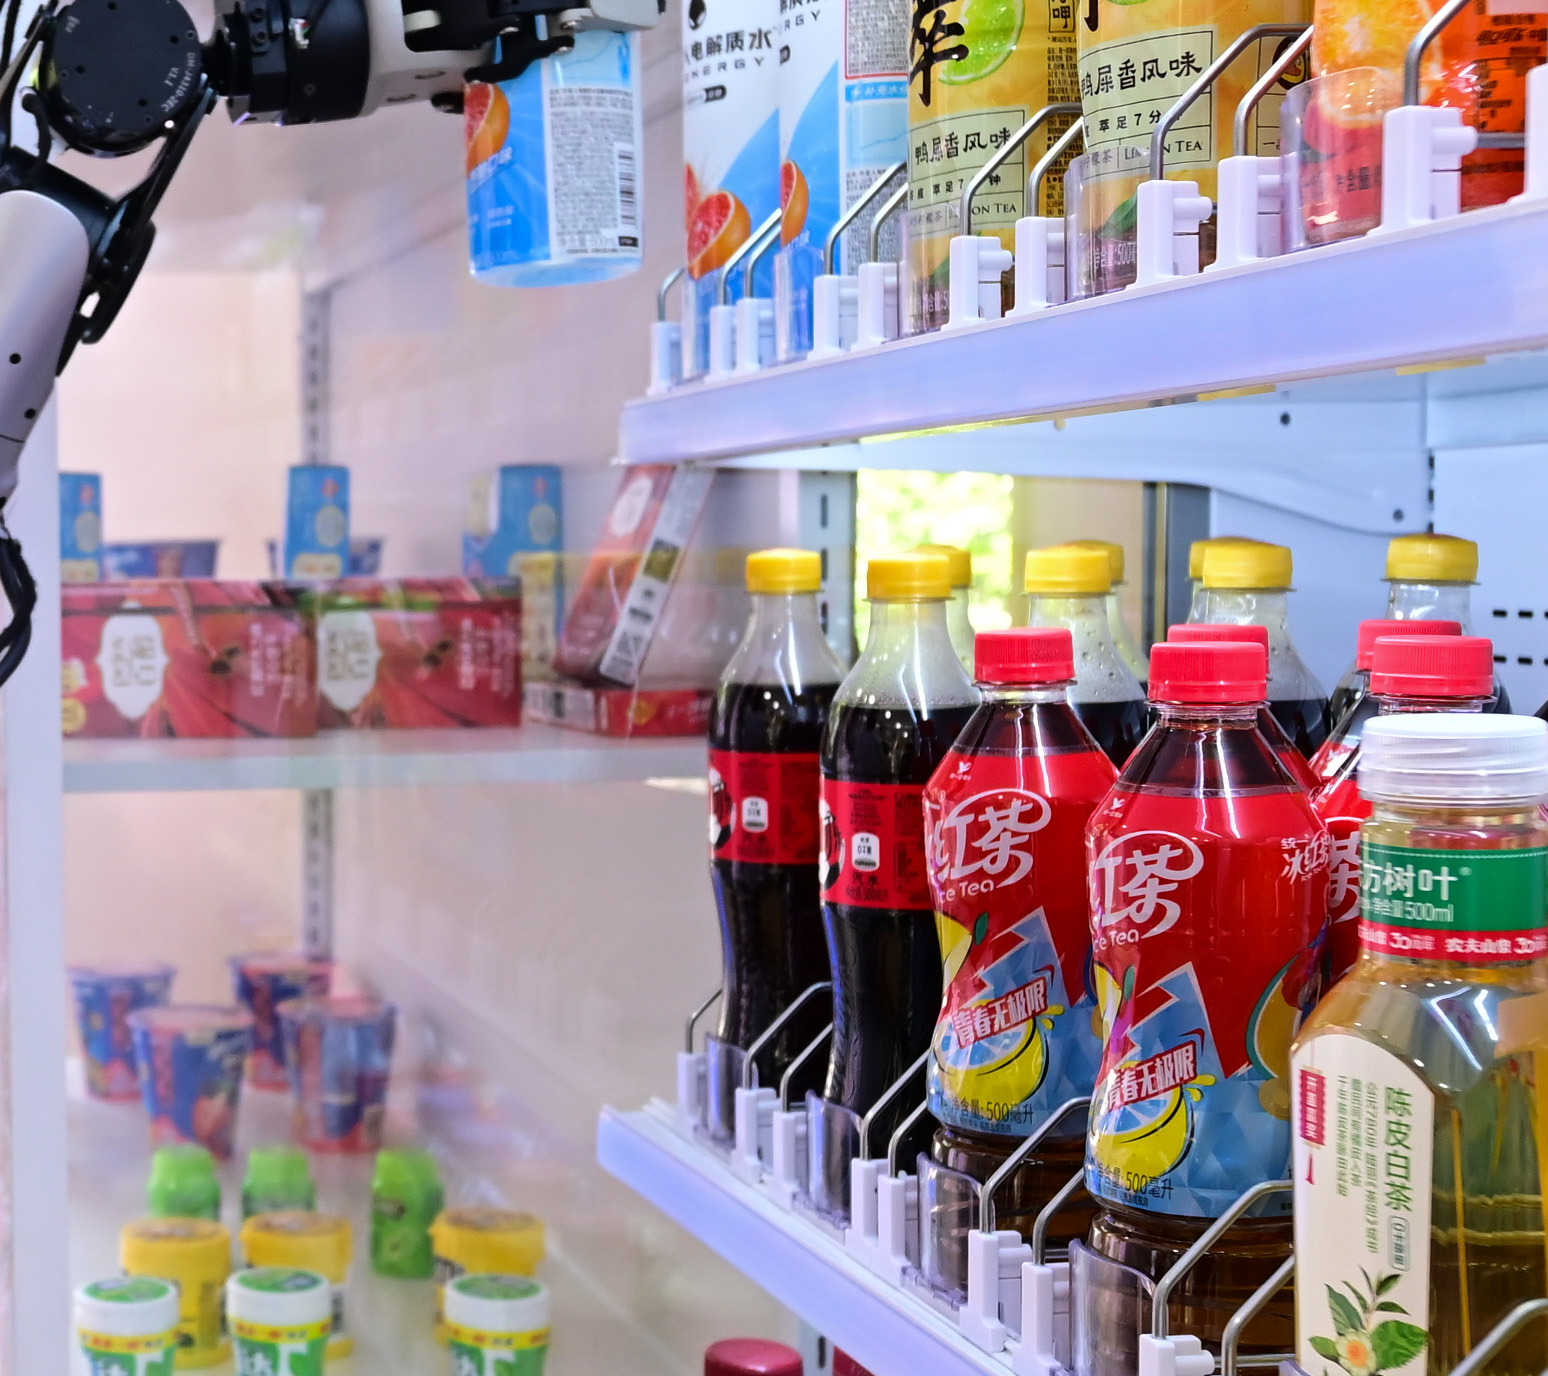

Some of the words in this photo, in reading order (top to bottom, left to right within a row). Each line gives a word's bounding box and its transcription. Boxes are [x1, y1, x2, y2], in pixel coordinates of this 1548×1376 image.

[1099, 109, 1176, 132] 萃足7分
[1175, 139, 1204, 152] TEA
[993, 202, 1017, 214] TEA
[939, 888, 955, 904] ce
[959, 879, 995, 897] Tea
[1093, 936, 1109, 953] ce
[1109, 929, 1140, 946] Tea
[1445, 937, 1512, 955] 农夫山泉
[950, 979, 1046, 1045] 青春无极限
[1384, 1085, 1413, 1213] 陈皮白茶
